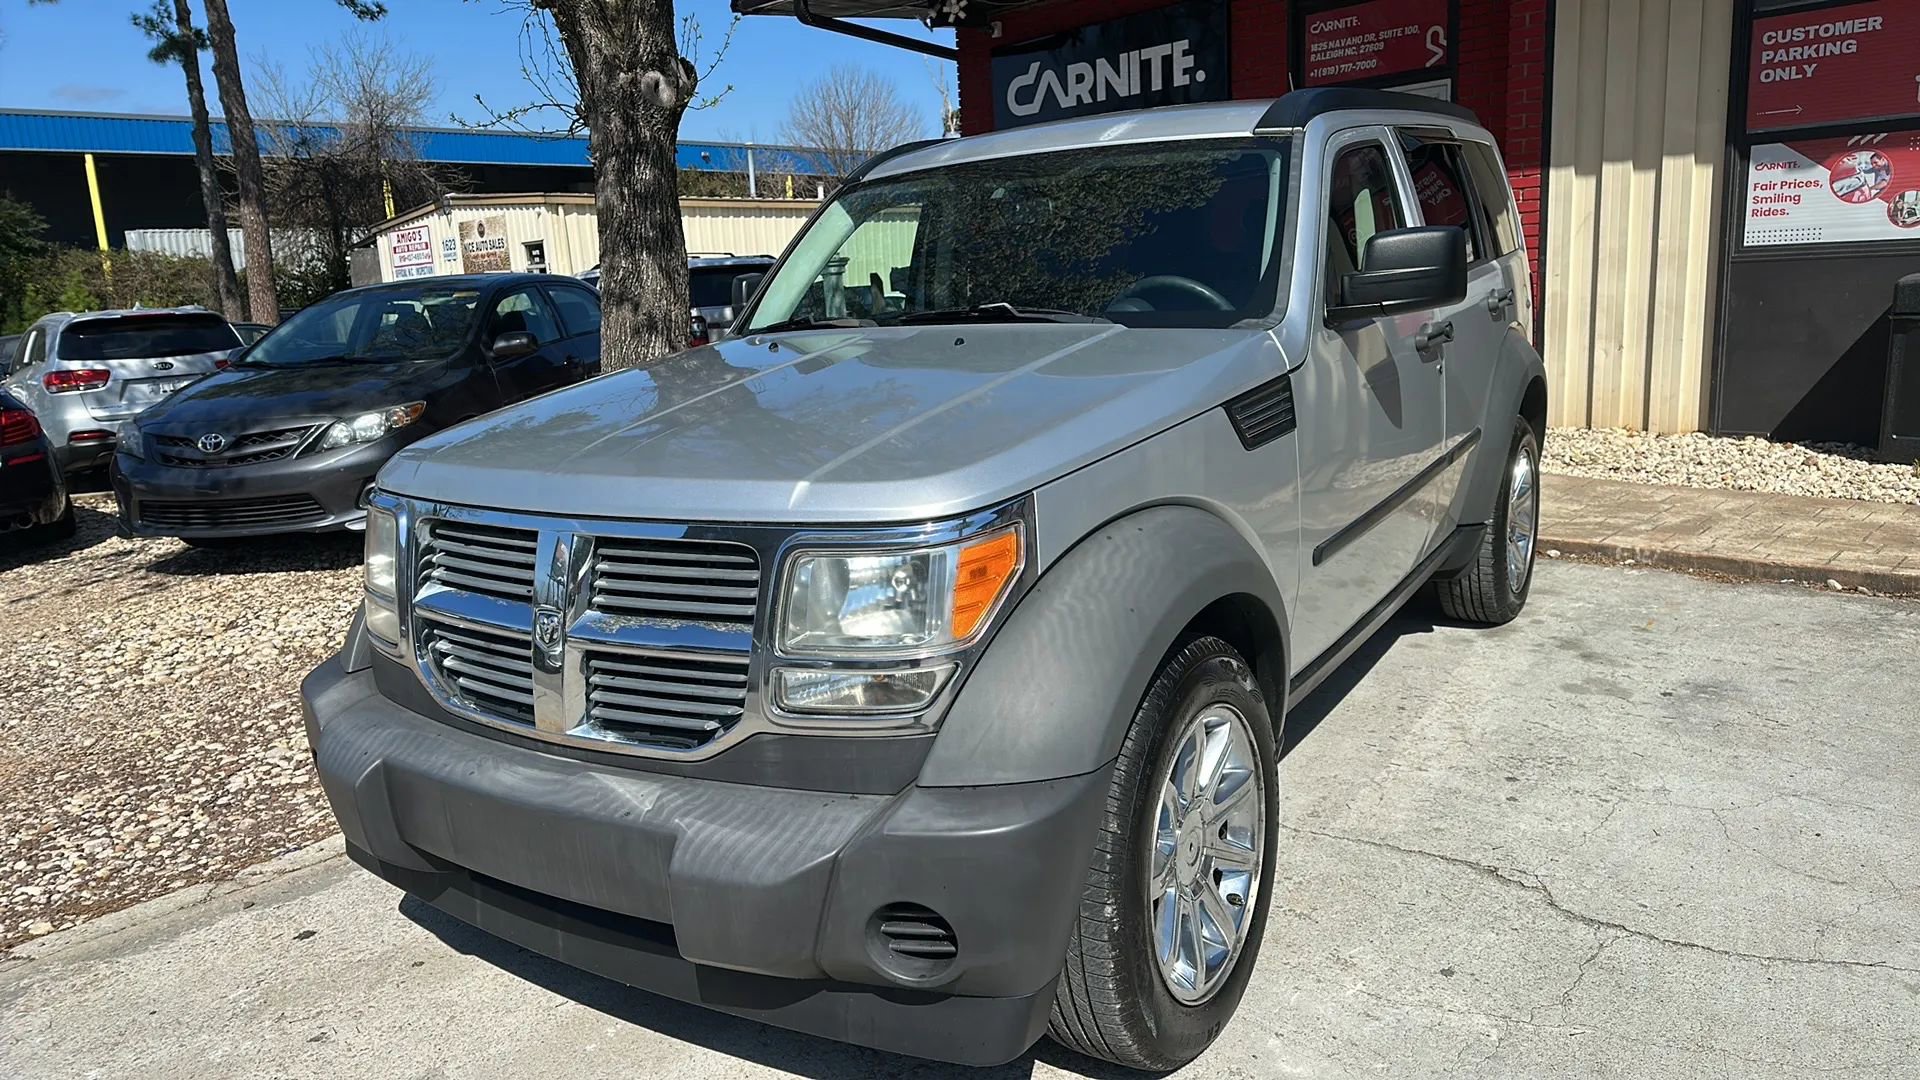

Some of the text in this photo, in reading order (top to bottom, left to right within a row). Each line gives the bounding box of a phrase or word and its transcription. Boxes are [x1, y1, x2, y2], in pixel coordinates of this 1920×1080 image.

[1762, 15, 1883, 45] CUSTOMER
[1328, 36, 1363, 49] NAVAHO
[1379, 28, 1403, 40] SUITE
[1310, 49, 1344, 62] RALEIGH
[1761, 39, 1857, 65] PARKING
[1340, 59, 1377, 73] 717-7000
[1760, 63, 1818, 83] ONLY
[1753, 178, 1823, 192] Fair Prices,
[1752, 193, 1802, 206] Smiling
[1751, 207, 1790, 218] Rides.
[396, 230, 422, 244] AMIGO'S
[442, 238, 456, 252] 1623
[463, 237, 505, 253] NICE AUTO SALES
